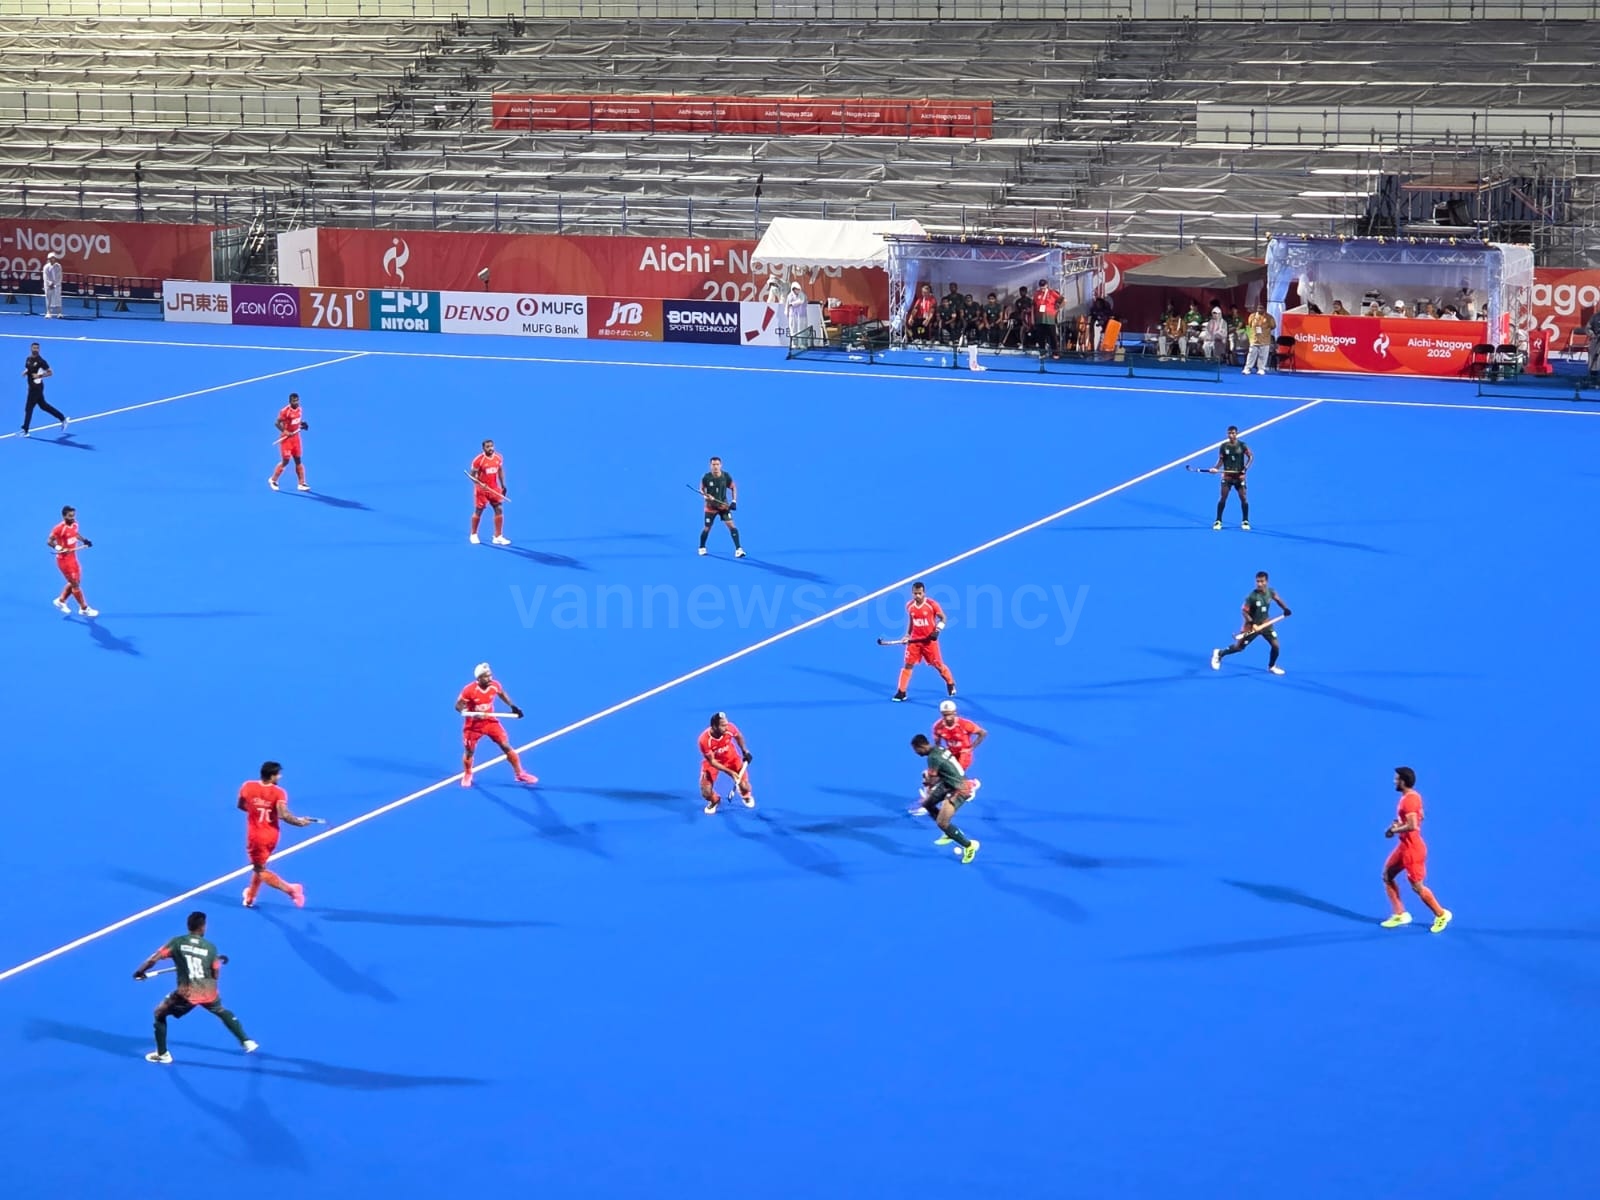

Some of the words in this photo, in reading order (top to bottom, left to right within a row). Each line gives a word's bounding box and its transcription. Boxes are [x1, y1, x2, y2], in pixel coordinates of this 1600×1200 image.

[765, 110, 799, 118] AichiNagoya
[0, 228, 110, 260] -Nagoya
[0, 256, 42, 280] 202
[167, 293, 228, 312] JR東海
[381, 291, 428, 313] ニトリ
[541, 301, 584, 315] MUFG
[444, 305, 510, 321] DENSO
[605, 302, 643, 327] JTB
[667, 310, 738, 326] BORNAN
[381, 317, 429, 330] NITORI
[522, 323, 552, 333] MUFG
[555, 324, 579, 334] Bank
[669, 324, 693, 332] SPORTS
[695, 325, 738, 333] TECHNOLOGY
[1294, 333, 1357, 346] Aichi-Nagoya
[1408, 338, 1473, 351] Aichi-Nagoya
[1313, 344, 1336, 353] 2026
[1427, 349, 1452, 358] 2026
